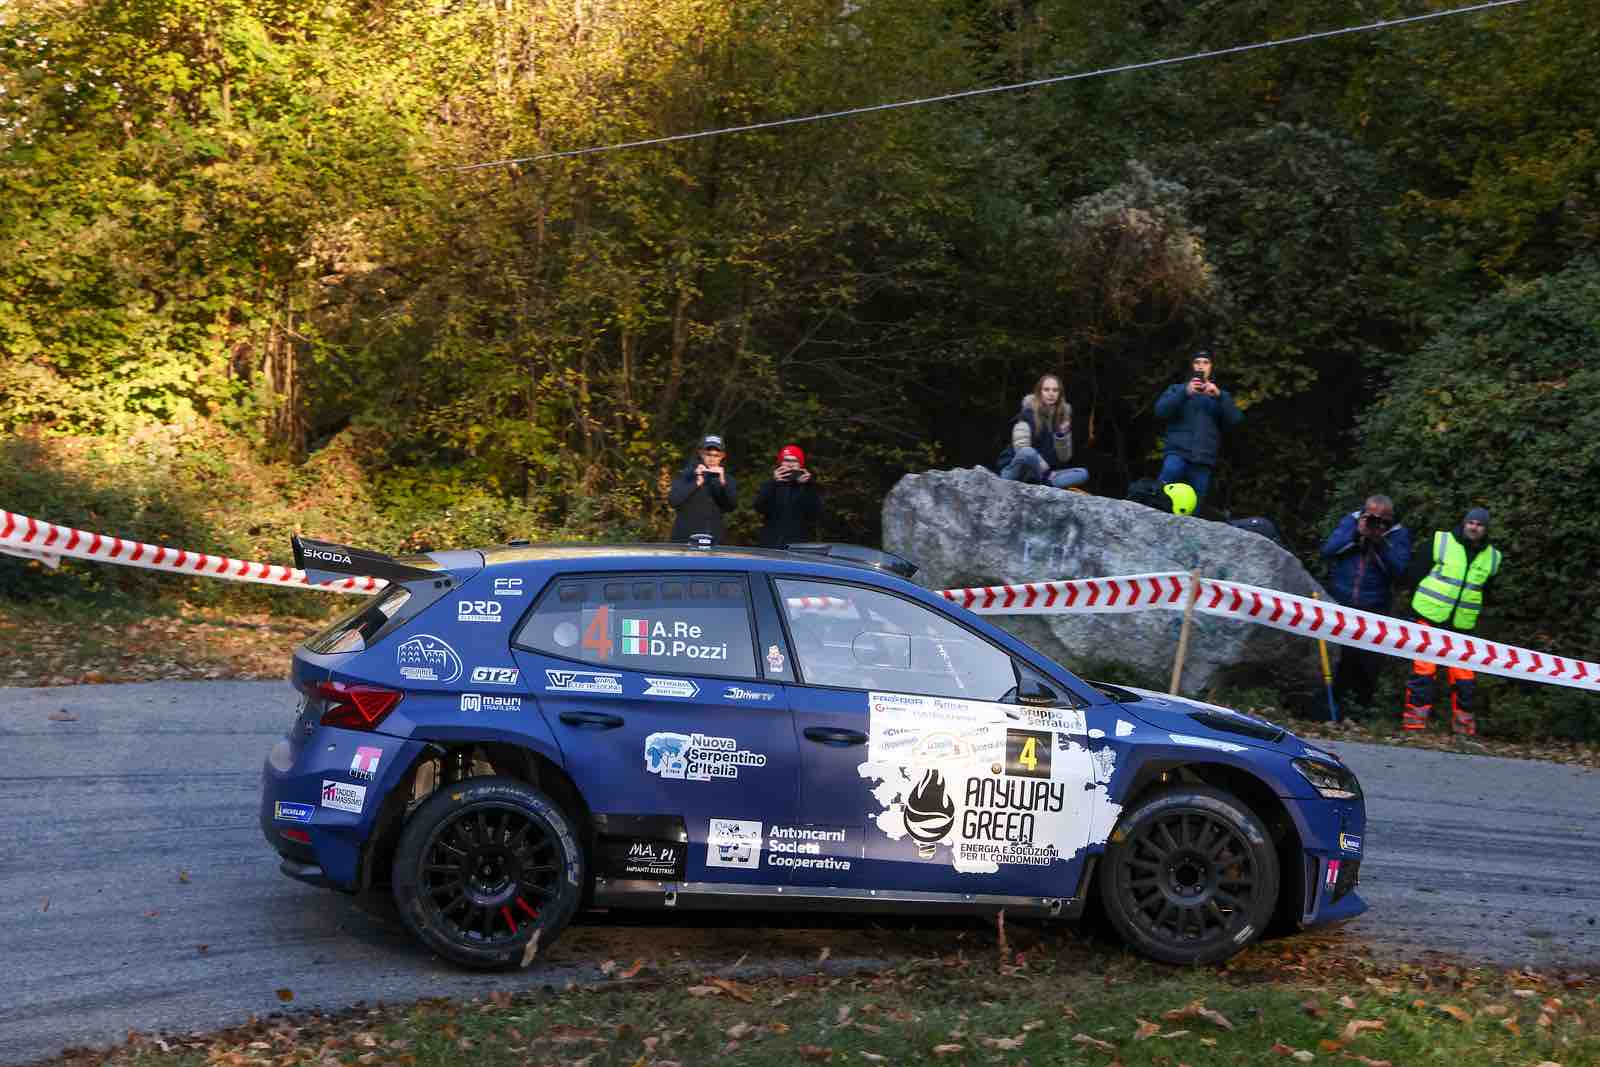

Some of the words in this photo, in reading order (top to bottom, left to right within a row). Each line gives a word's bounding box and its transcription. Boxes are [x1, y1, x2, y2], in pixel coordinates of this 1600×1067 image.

[458, 601, 502, 615] DRD
[583, 604, 613, 662] 4
[652, 621, 702, 638] A.Re
[650, 639, 727, 660] D.Pozzi
[482, 696, 521, 706] mauri
[692, 735, 735, 749] Nuova
[691, 749, 765, 766] Serpentino
[1019, 736, 1038, 771] 4
[689, 763, 736, 776] d'Italia
[965, 777, 1065, 812] ANYWAY
[769, 825, 846, 842] Antoncarni
[962, 809, 1035, 843] GREEN
[960, 852, 978, 862] PER
[980, 853, 989, 862] IL
[990, 854, 1050, 866] CONDOMINIO
[961, 843, 1000, 854] ENERGIA
[1002, 846, 1009, 855] E
[1009, 847, 1060, 858] SOLUZIONI
[768, 854, 851, 870] Cooperativa
